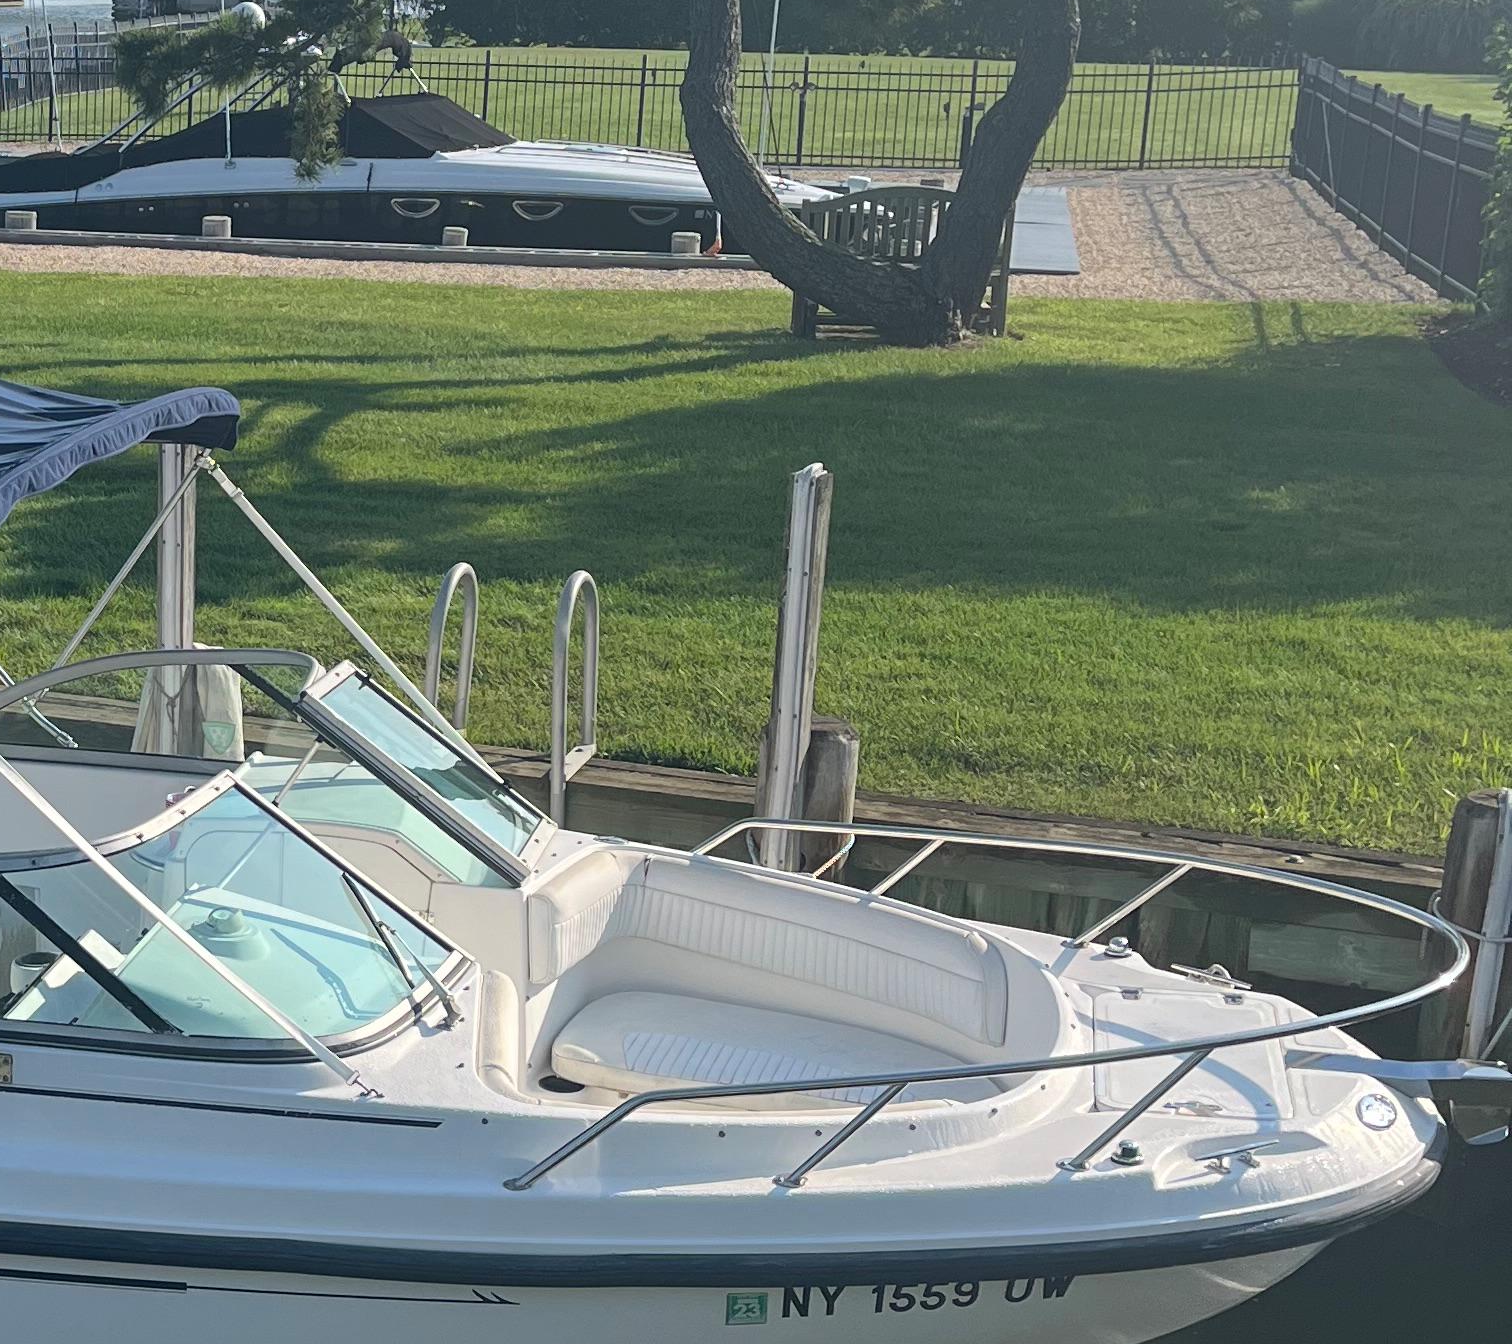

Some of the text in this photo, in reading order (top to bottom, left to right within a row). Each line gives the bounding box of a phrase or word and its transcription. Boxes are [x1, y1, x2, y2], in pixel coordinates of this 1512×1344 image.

[733, 1303, 761, 1318] 23
[782, 1277, 1075, 1317] NY 1559 UW
